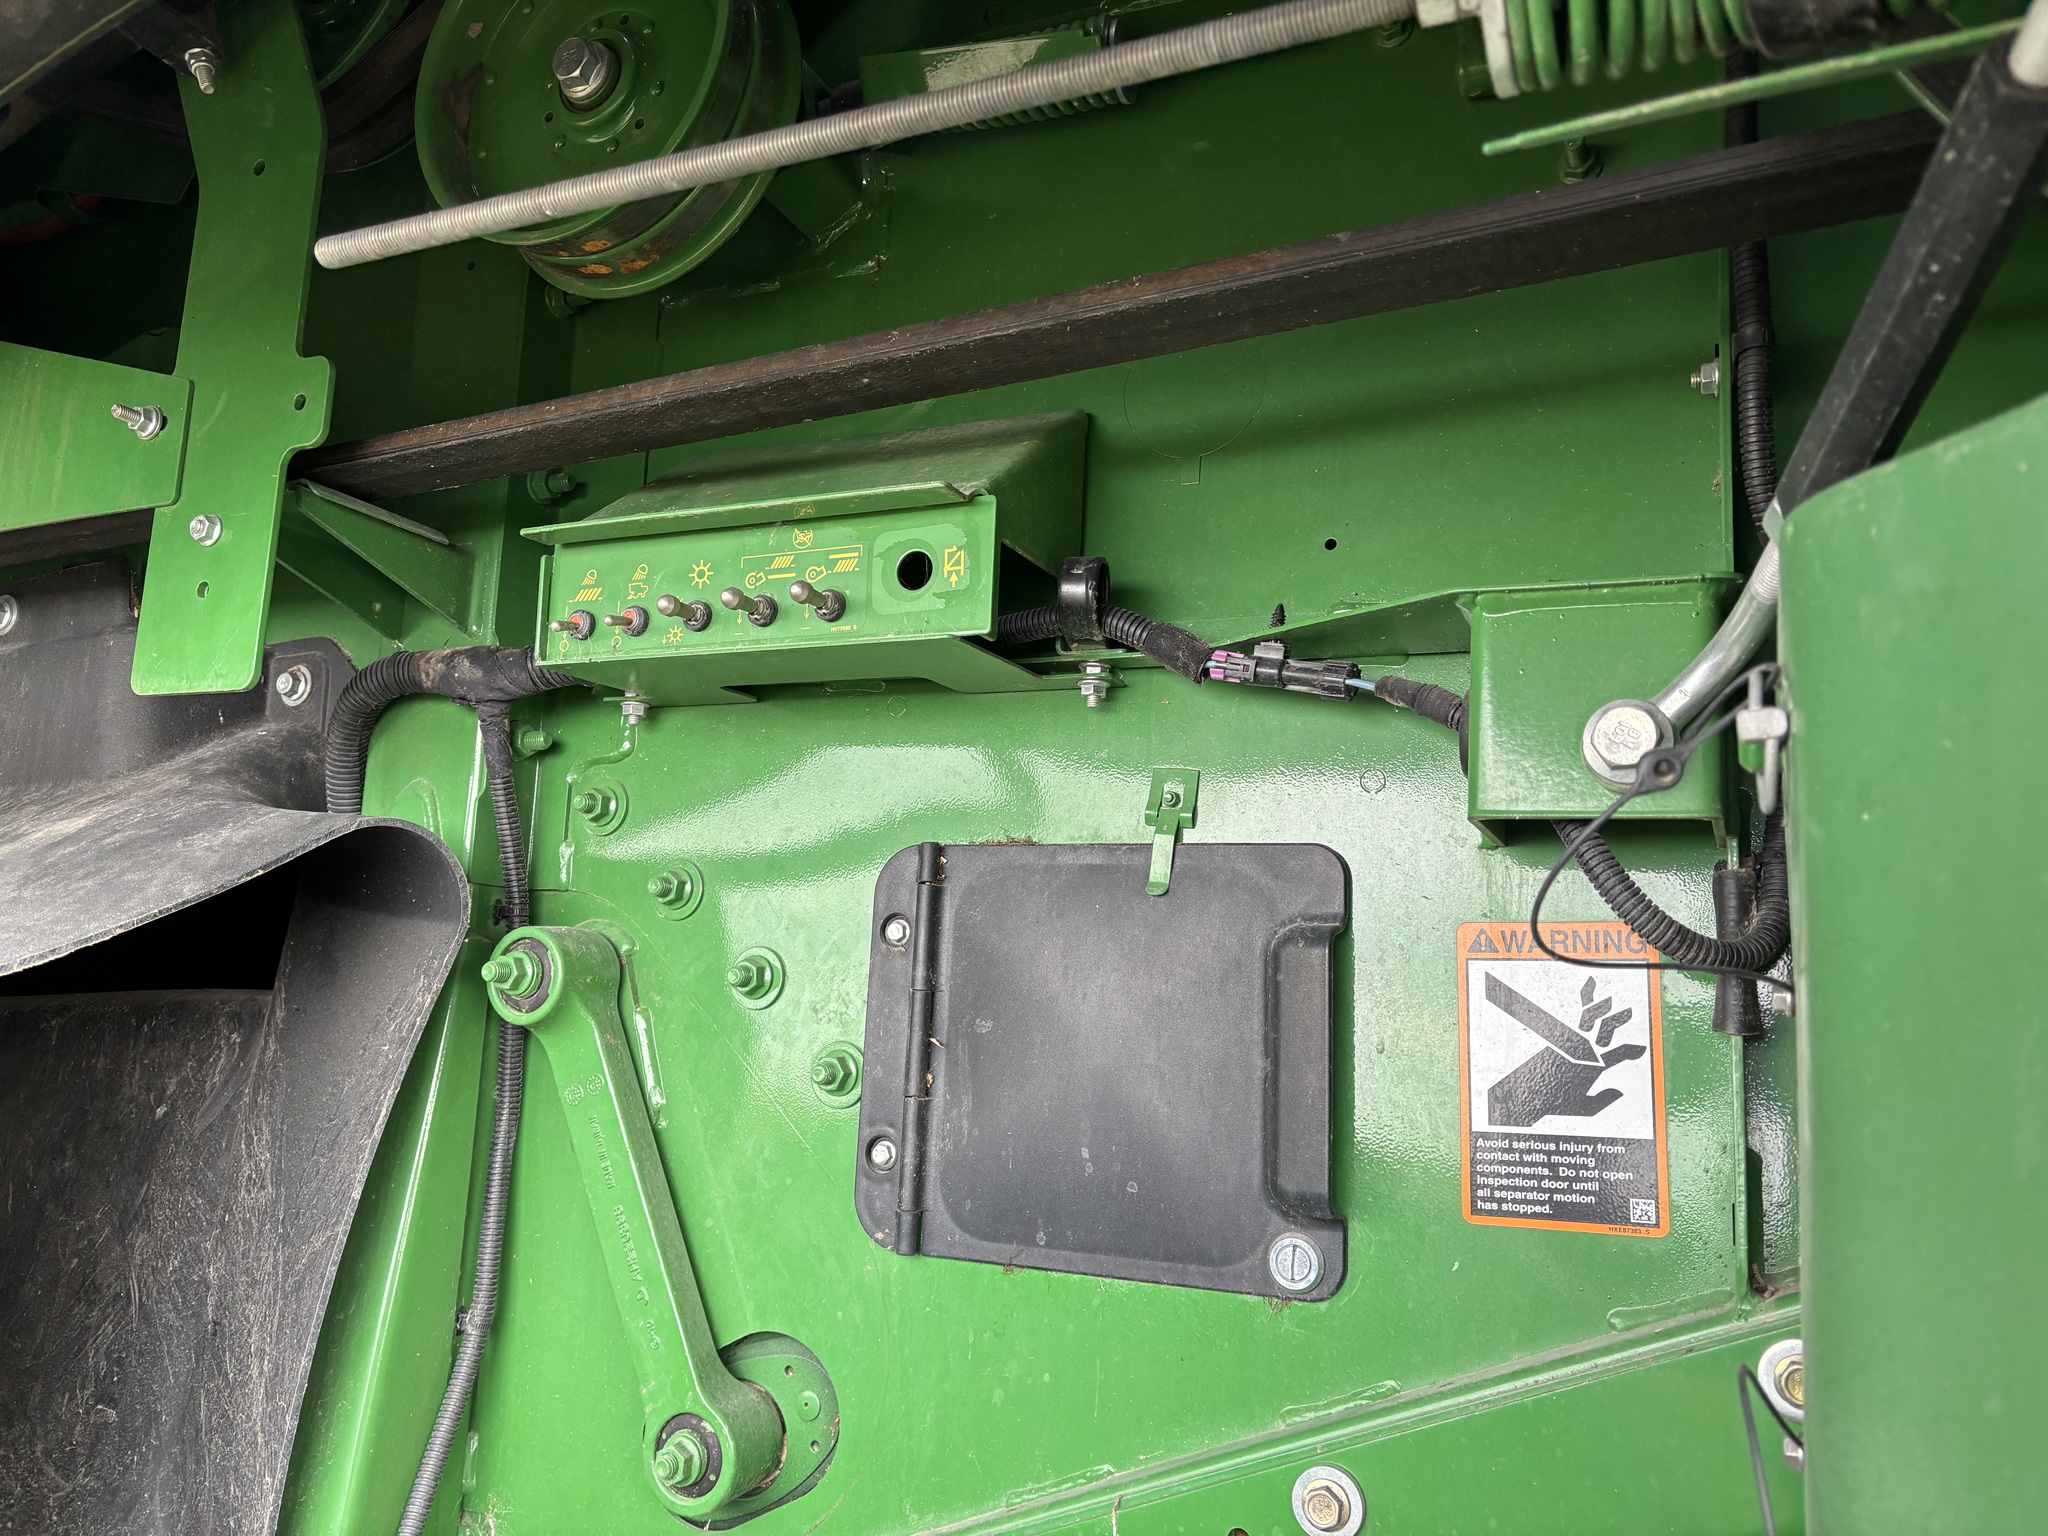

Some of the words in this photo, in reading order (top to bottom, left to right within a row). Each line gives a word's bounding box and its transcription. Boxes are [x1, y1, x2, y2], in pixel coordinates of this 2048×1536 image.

[1477, 1138, 1509, 1148] Avoid
[1512, 1141, 1556, 1150] serious
[1559, 1142, 1593, 1154] injury
[1597, 1143, 1625, 1154] from
[1477, 1151, 1519, 1161] contact
[1523, 1153, 1547, 1162] with
[1551, 1156, 1595, 1167] moving
[1477, 1165, 1552, 1176] components.
[1559, 1167, 1575, 1177] Do
[1579, 1170, 1599, 1178] not
[1602, 1171, 1633, 1180] open
[1477, 1175, 1538, 1189] inspection
[1541, 1179, 1569, 1189] door
[1572, 1181, 1599, 1191] until
[1477, 1188, 1490, 1197] all
[1494, 1190, 1550, 1202] separator
[1553, 1193, 1595, 1203] motion
[1477, 1200, 1498, 1210] has
[1501, 1202, 1552, 1214] stopped.
